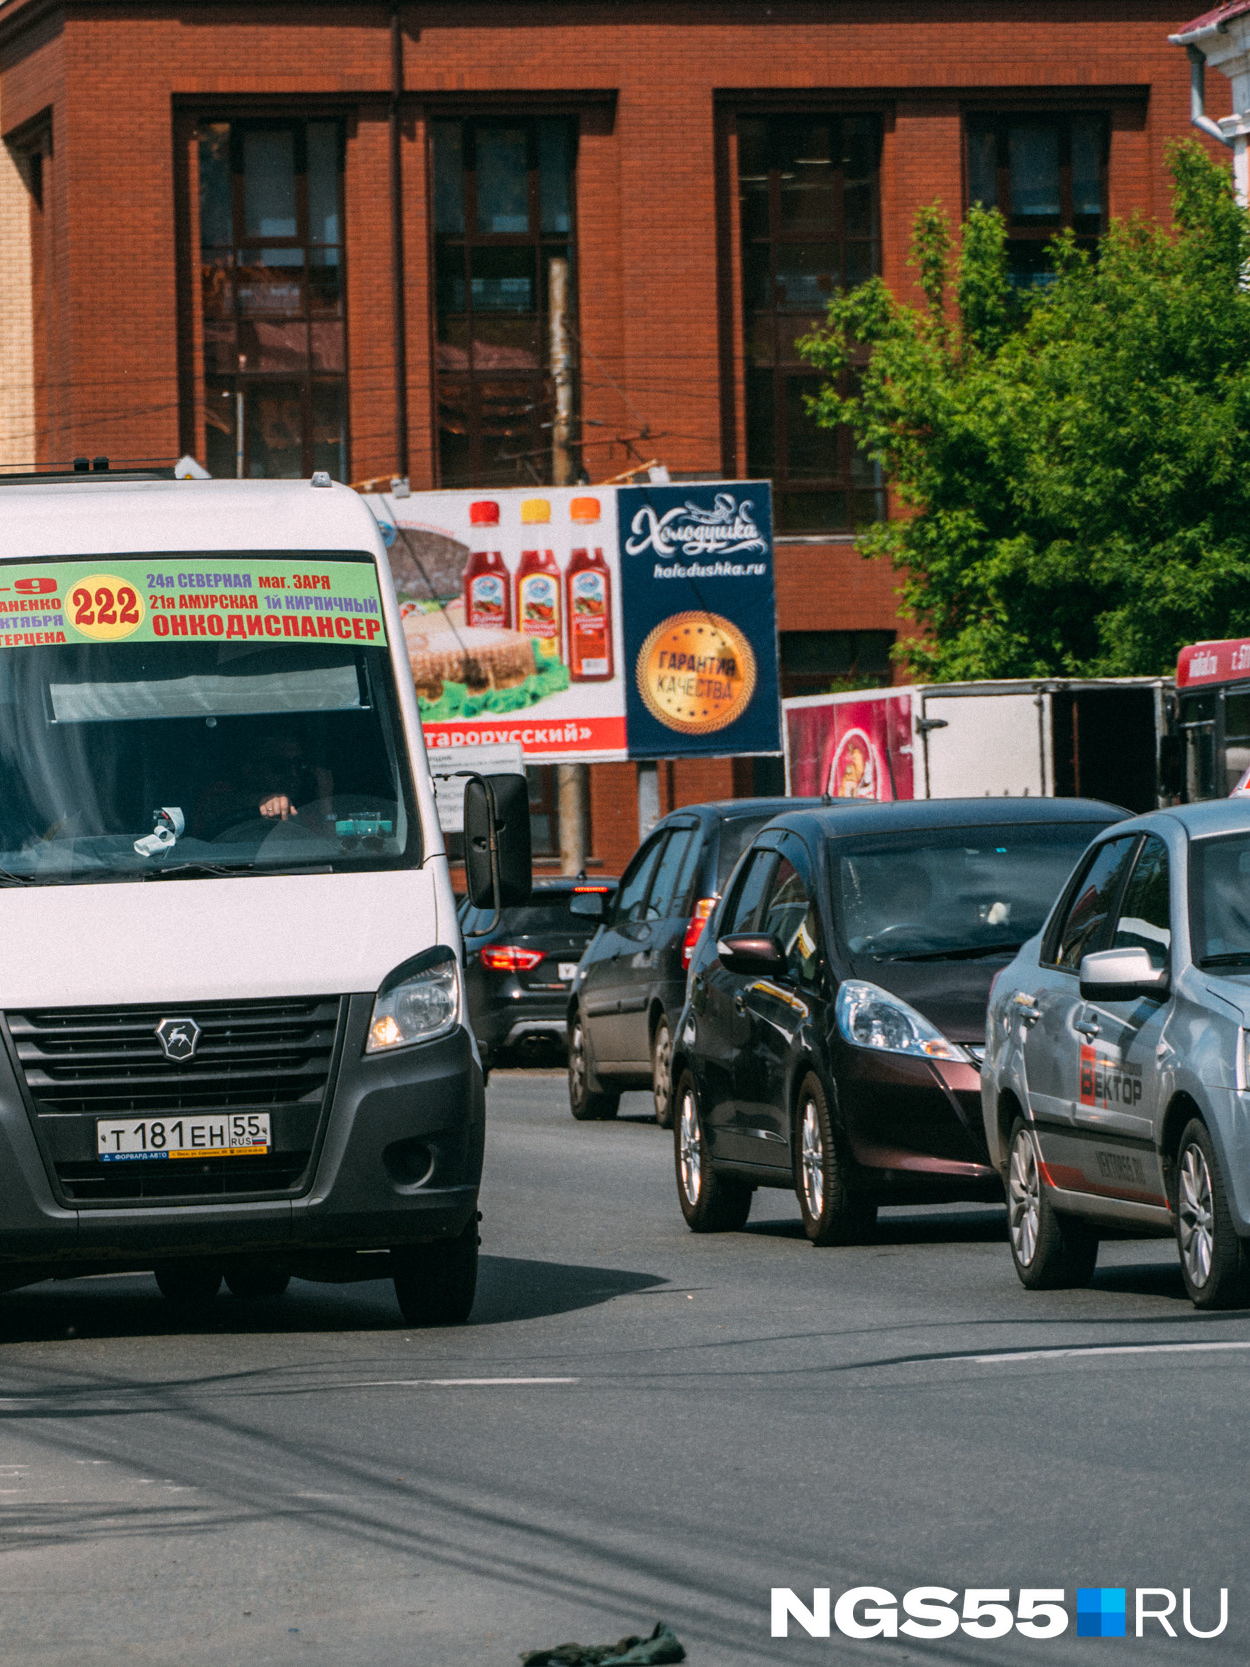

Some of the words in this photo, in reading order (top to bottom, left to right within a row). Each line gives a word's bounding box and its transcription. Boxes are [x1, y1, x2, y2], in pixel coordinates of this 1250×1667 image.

[626, 502, 767, 558] Холодушка
[146, 573, 175, 589] 24я
[177, 573, 253, 589] СЕВЕРНАЯ
[258, 575, 290, 590] маг.
[292, 574, 332, 590] ЗАРЯ
[653, 561, 767, 579] holodushka.ru
[72, 586, 140, 626] 222
[149, 594, 177, 610] 21я
[178, 594, 259, 610] АМУРСКАЯ
[264, 594, 283, 610] 1й
[285, 595, 379, 614] КИРПИЧНЫЙ
[152, 614, 382, 641] ОНКОДИСПАНСЕР
[658, 651, 736, 678] ГАРАНТИЯ
[656, 674, 733, 700] КАЧЕСТВА
[424, 723, 593, 748] тарорусский»
[233, 1115, 261, 1137] 55
[231, 1137, 252, 1146] RUS
[114, 1151, 168, 1161] ФОРВАРД-АВТО
